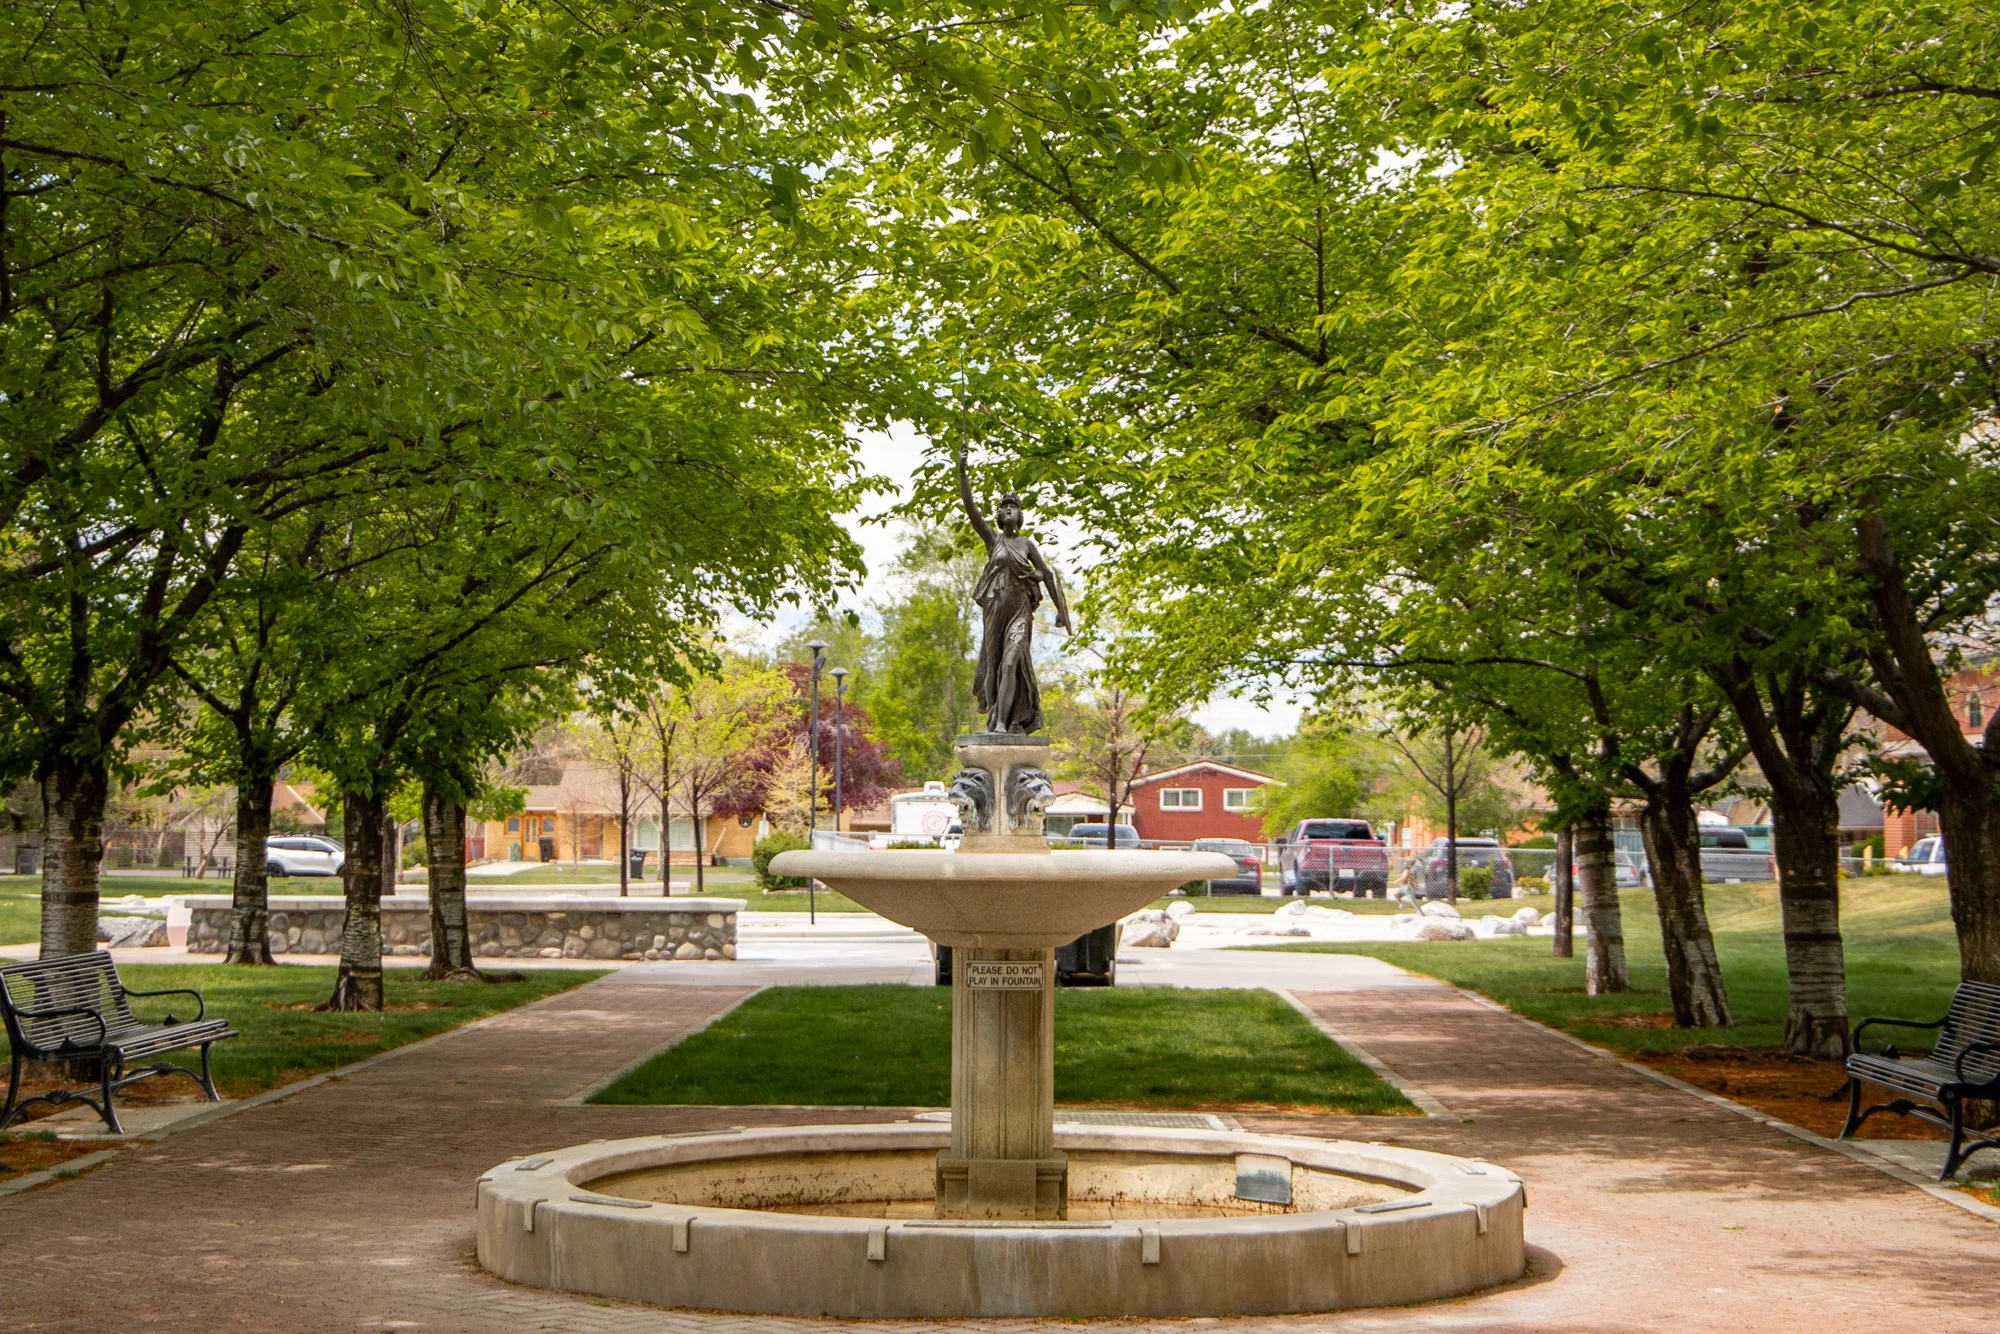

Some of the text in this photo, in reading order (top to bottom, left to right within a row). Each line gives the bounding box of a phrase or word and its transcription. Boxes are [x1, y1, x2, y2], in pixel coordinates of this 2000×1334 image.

[972, 966, 1037, 974] PLEASE DO NOT
[969, 977, 1041, 985] PLAY IN FOUNTAIN
